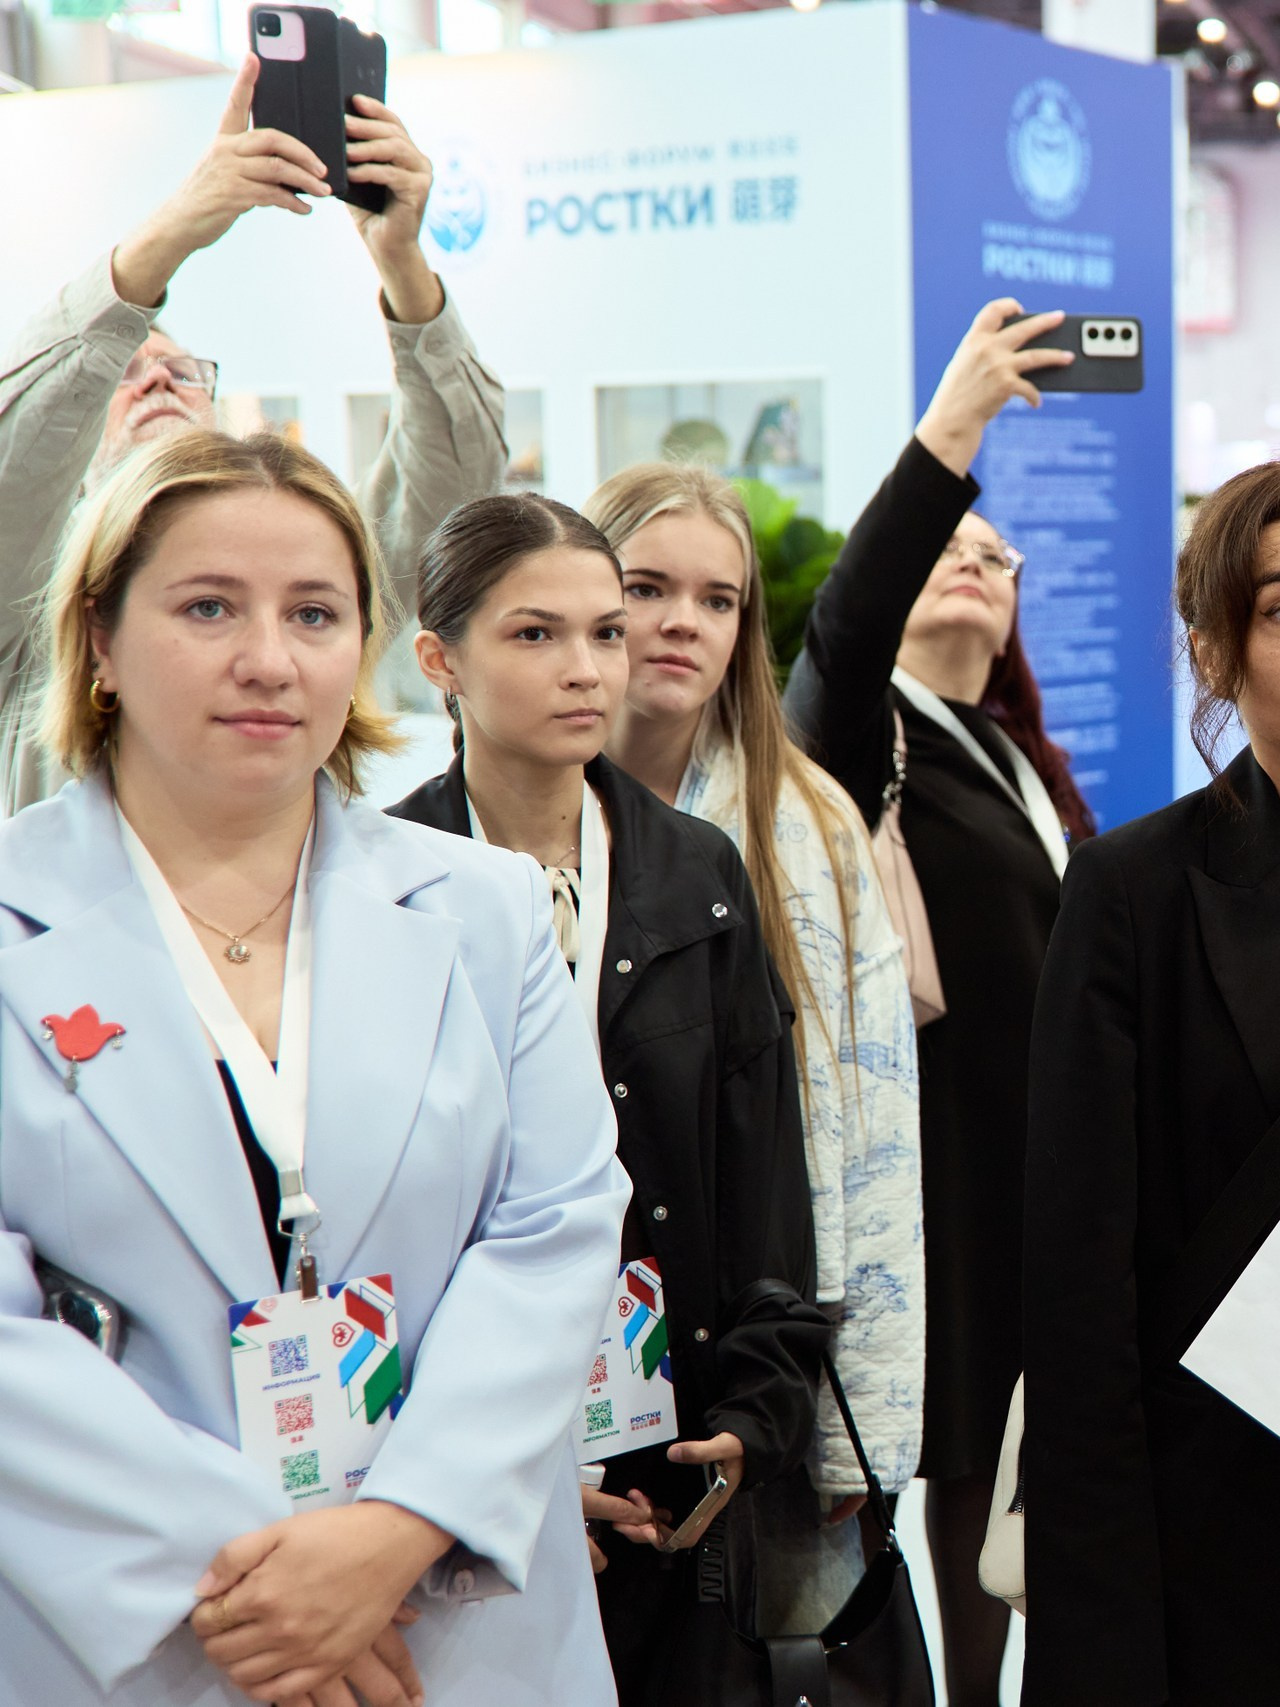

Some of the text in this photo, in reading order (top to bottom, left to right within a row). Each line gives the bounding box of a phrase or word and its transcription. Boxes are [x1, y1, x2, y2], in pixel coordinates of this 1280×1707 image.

[526, 184, 714, 236] РОСТКИ
[262, 1373, 321, 1391] ИНФОРМАЦИЯ
[630, 1411, 661, 1424] РОСТКИ
[582, 1430, 621, 1443] INFORMATION
